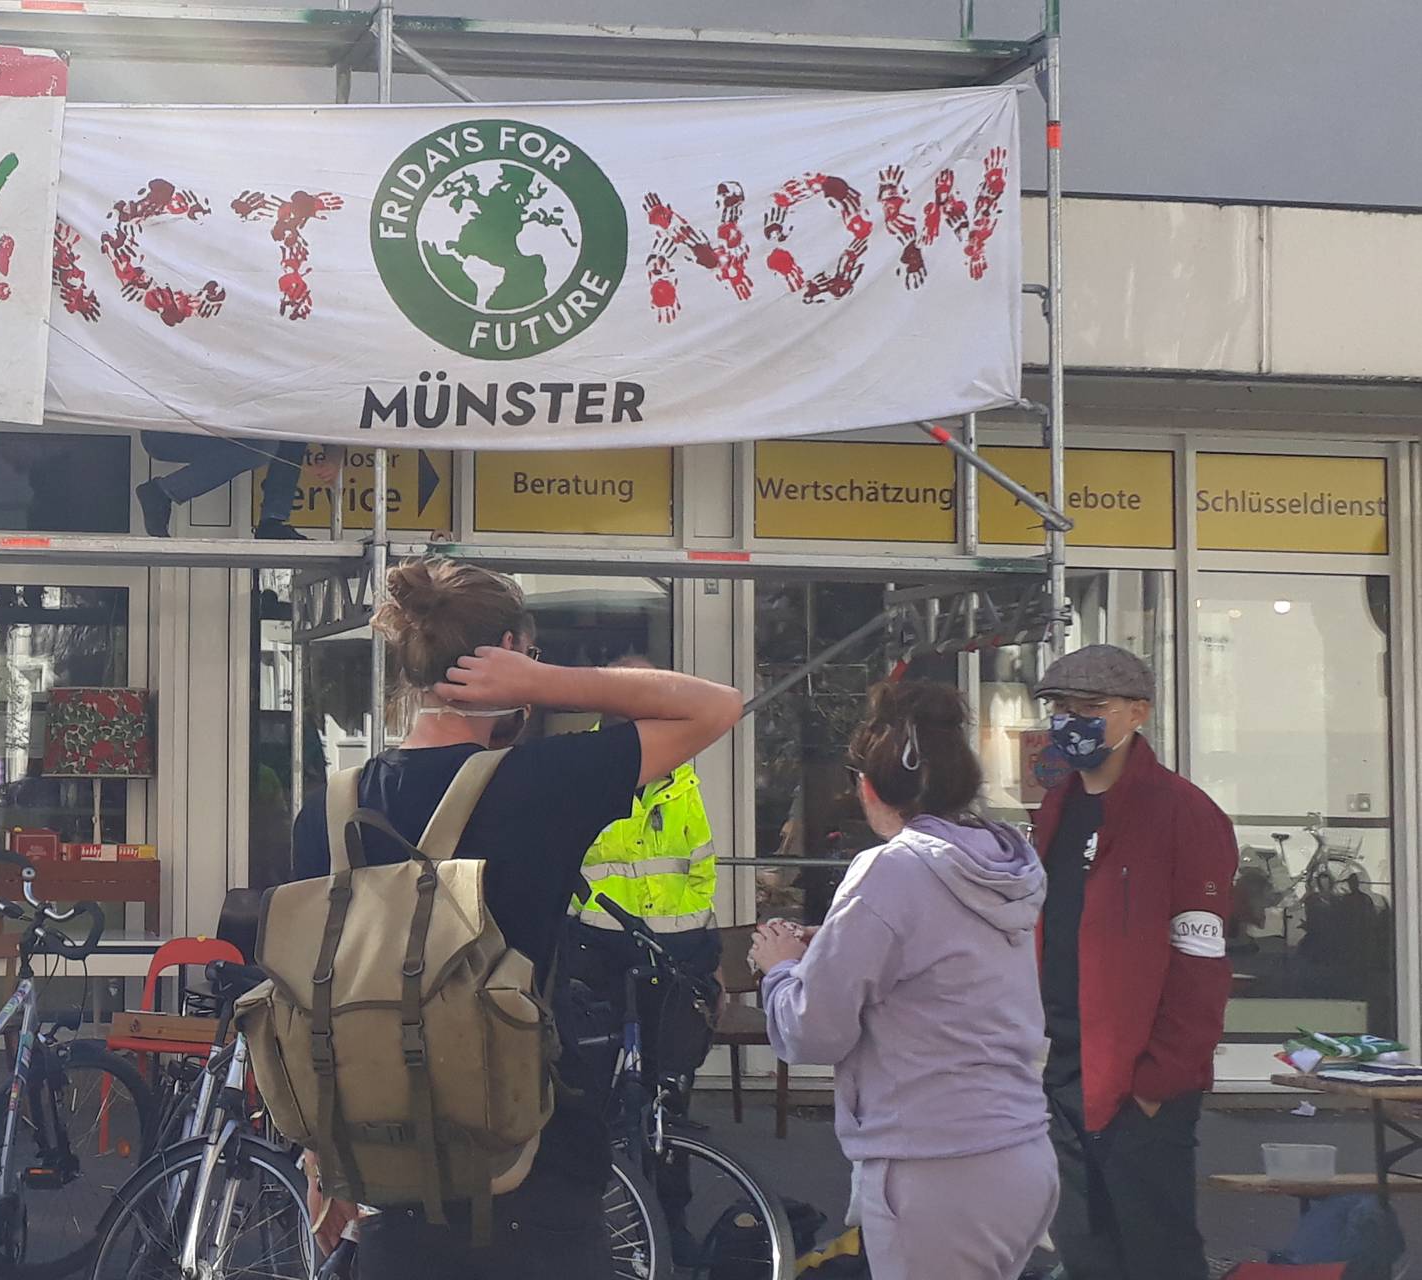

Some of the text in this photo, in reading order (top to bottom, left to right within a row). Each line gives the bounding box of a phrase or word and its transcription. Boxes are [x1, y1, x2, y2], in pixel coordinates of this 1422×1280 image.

[379, 127, 571, 240] FRIDAYS FOR
[643, 146, 1008, 324] NOW
[469, 269, 611, 351] FUTURE
[359, 371, 646, 428] MÜNSTER
[262, 478, 402, 513] ervice
[513, 471, 636, 503] Beratung
[756, 477, 954, 511] Wertschätzung
[1195, 490, 1388, 518] Schlüsseldienst
